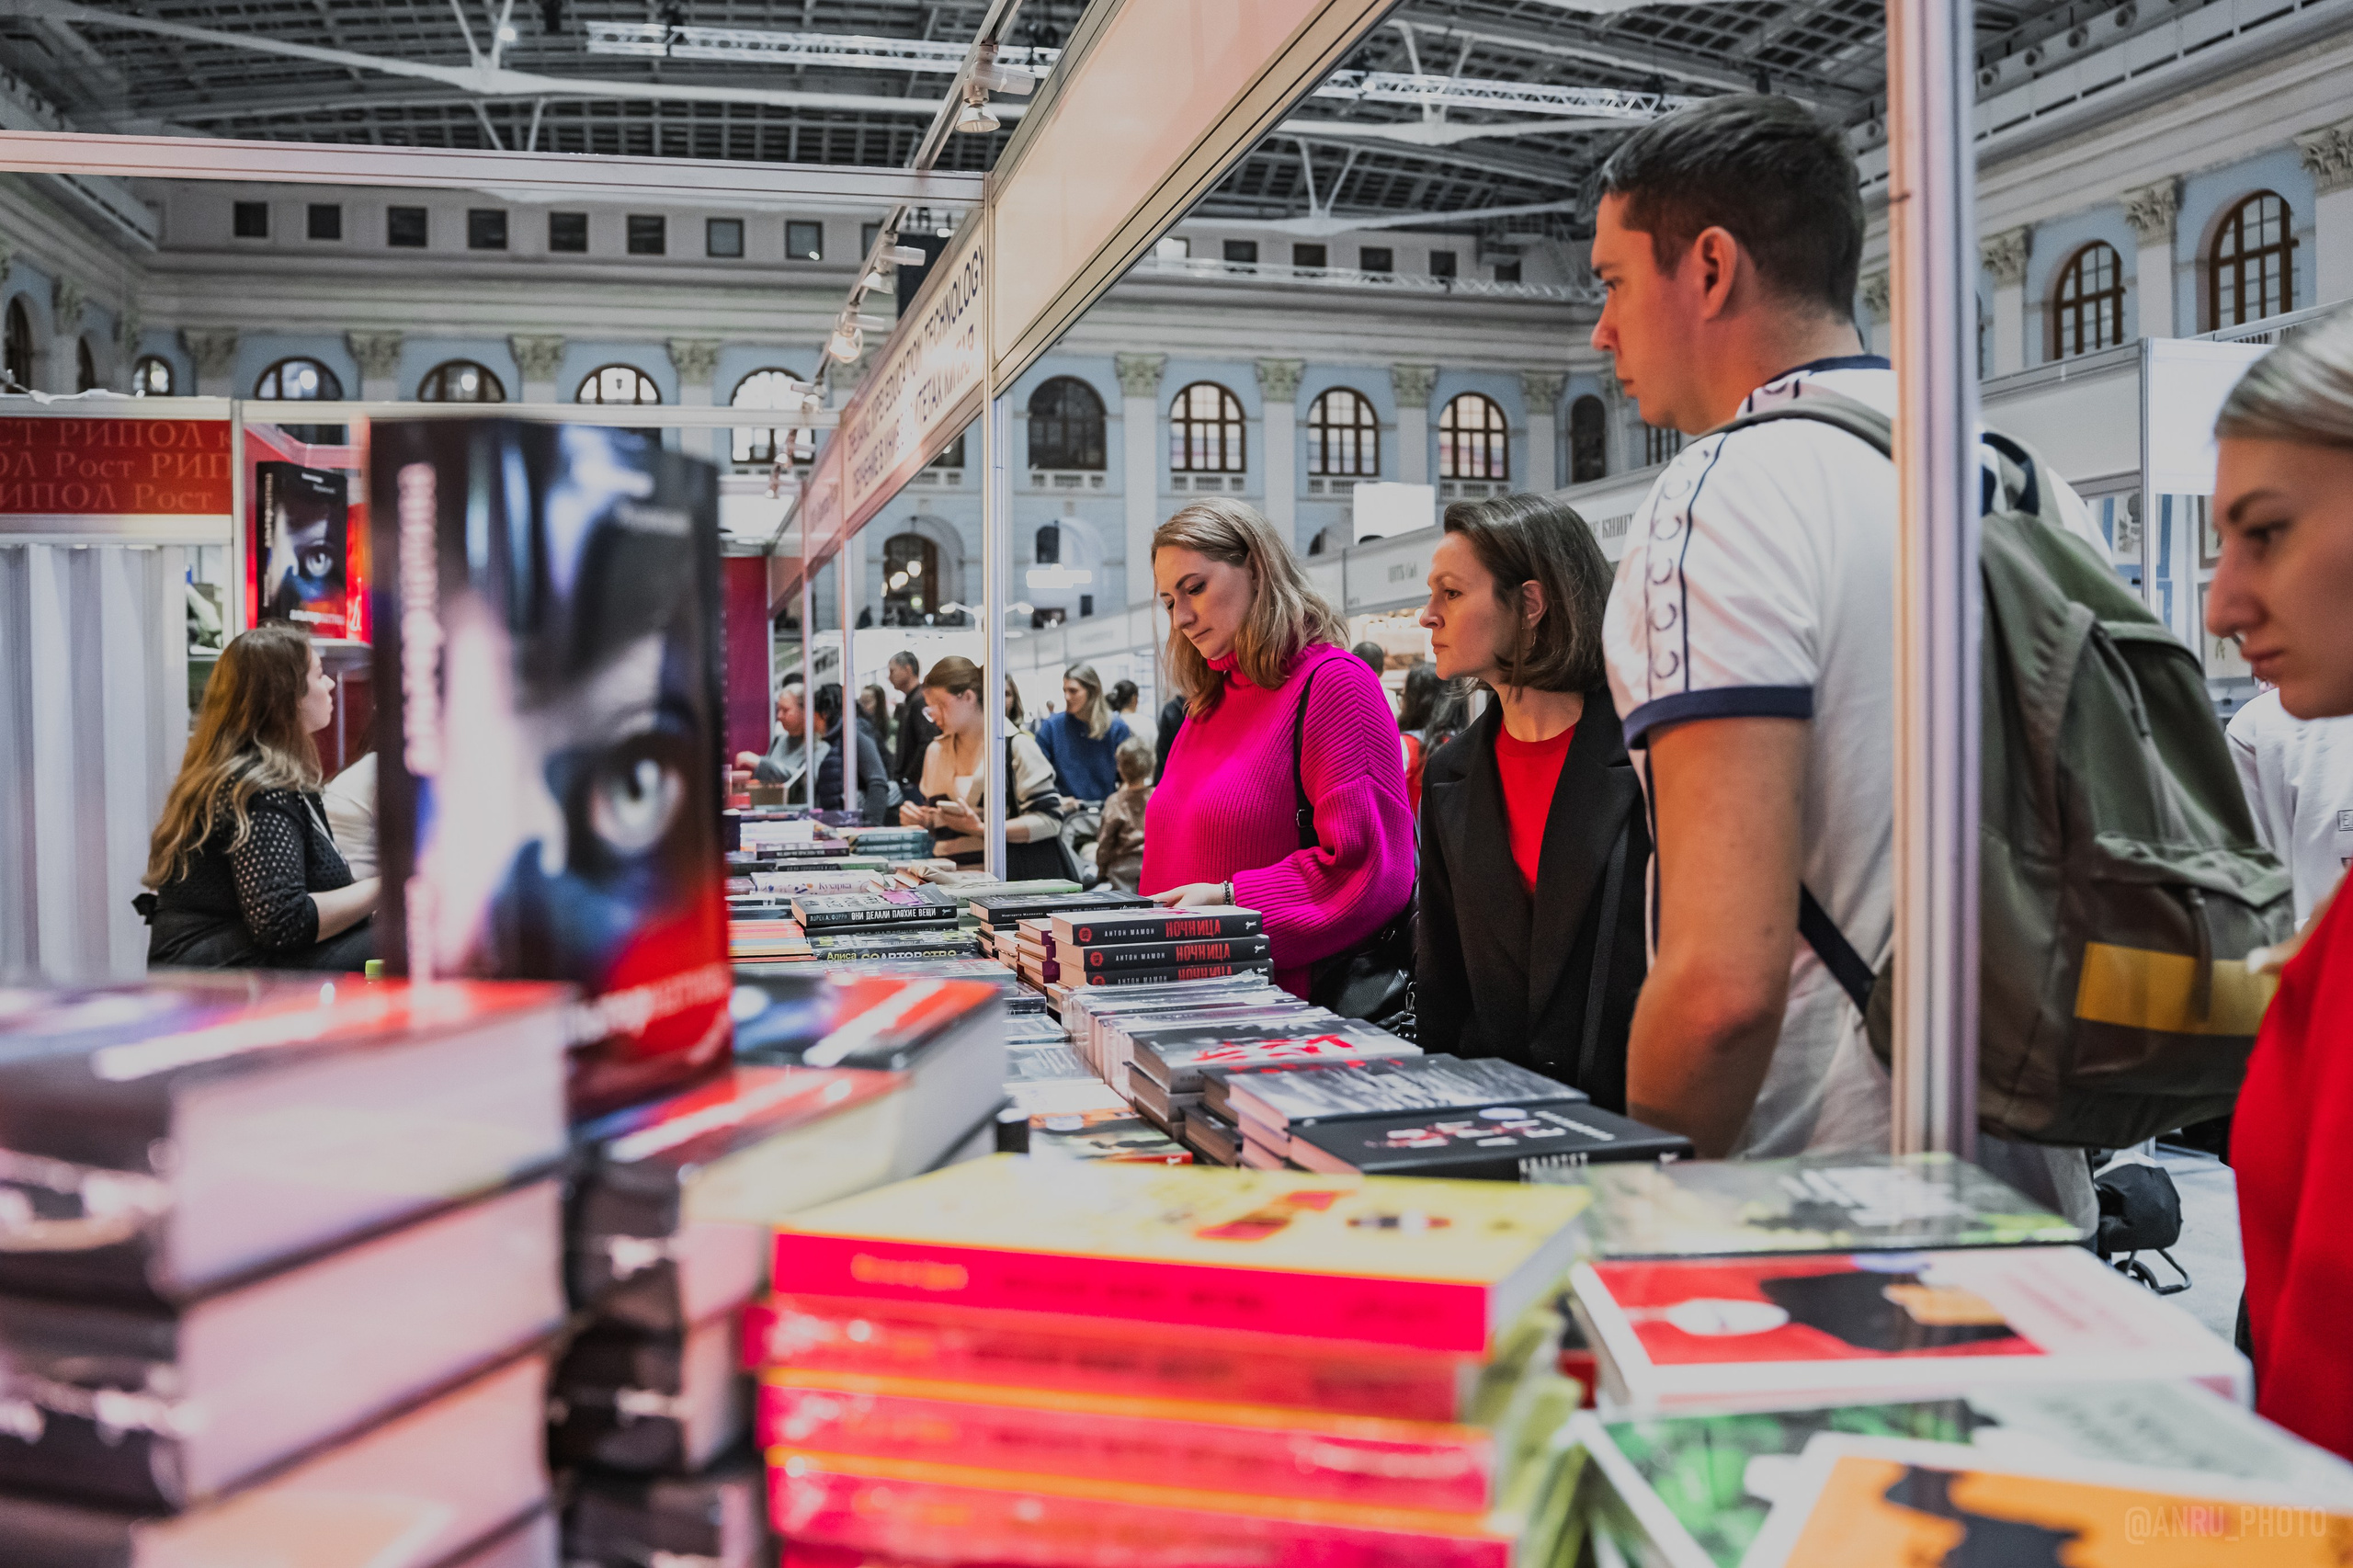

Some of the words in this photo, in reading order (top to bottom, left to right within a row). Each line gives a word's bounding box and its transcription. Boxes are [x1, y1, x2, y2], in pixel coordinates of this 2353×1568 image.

[59, 420, 203, 448] РИПОЛ
[819, 882, 852, 892] Кухарка
[851, 911, 864, 921] ОНИ
[866, 910, 890, 921] ДЕЛАЛИ
[892, 909, 916, 918] ПЛОХИЕ
[918, 907, 937, 917] ВЕЩИ
[1104, 929, 1127, 937] АНТОН
[1130, 927, 1154, 936] МАМОН
[1165, 919, 1222, 938] НОЧНИЦА
[1115, 953, 1138, 961] АНТОН
[1141, 951, 1165, 960] МАМОН
[1176, 943, 1231, 962] НОЧНИЦА
